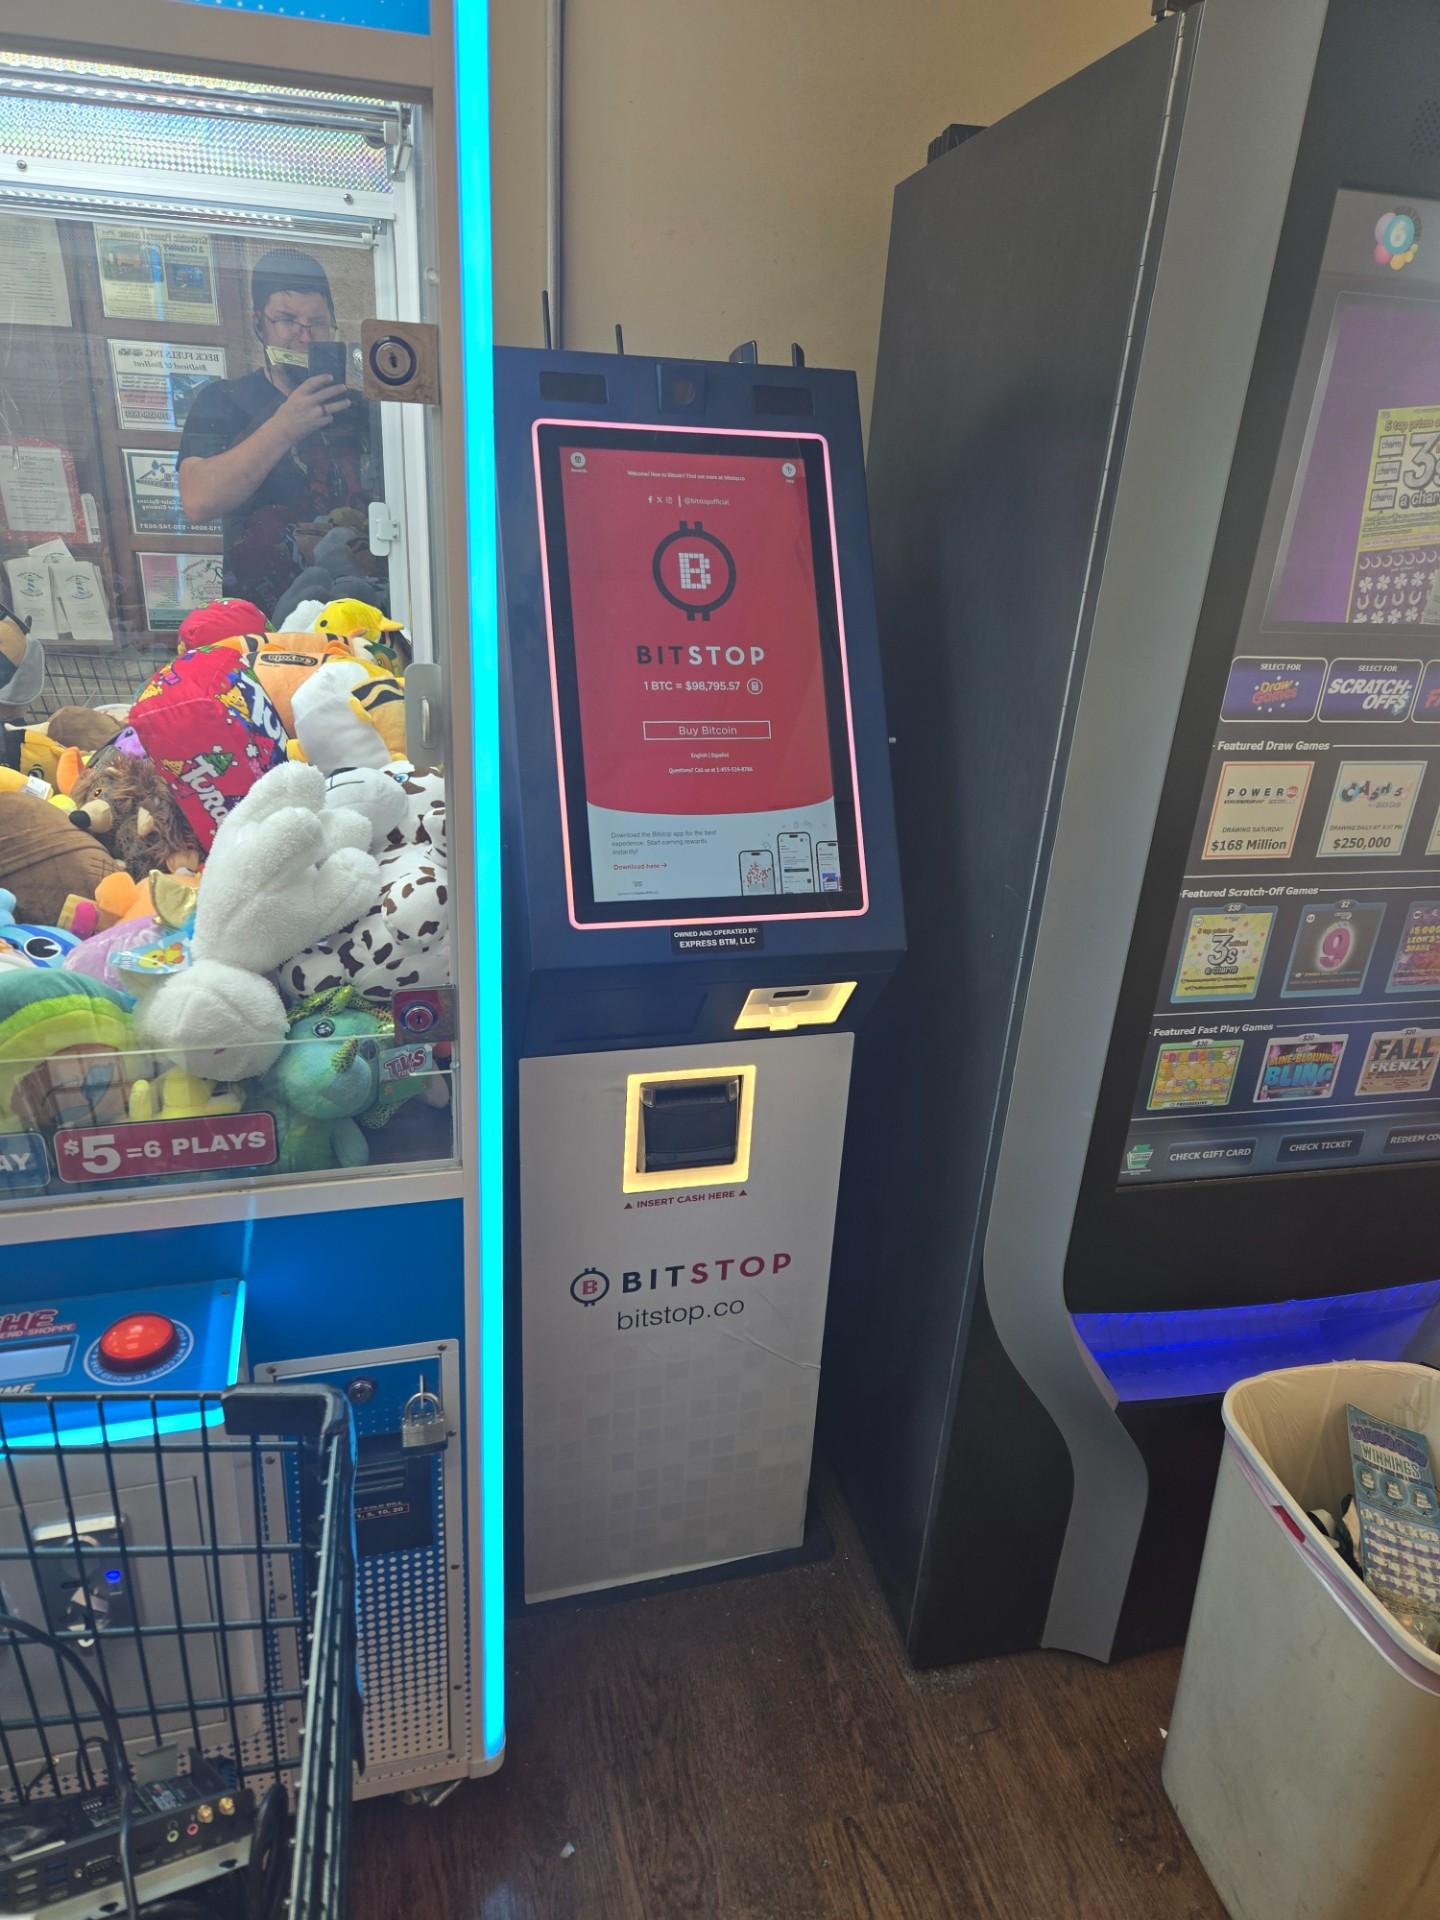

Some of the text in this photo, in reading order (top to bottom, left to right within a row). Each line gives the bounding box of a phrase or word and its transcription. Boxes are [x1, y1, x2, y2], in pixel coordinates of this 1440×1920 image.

[636, 645, 765, 666] BITSTOP
[1260, 663, 1285, 671] SELECT
[644, 681, 649, 691] 1
[651, 681, 673, 691] BTC
[1260, 680, 1294, 693] Draw
[678, 725, 737, 738] Buy Bitcoin
[1217, 741, 1330, 750] Featured Draw Games
[1227, 787, 1285, 797] POWER
[1252, 825, 1284, 833] SATURDAY
[1211, 839, 1287, 851] $168 Million
[1333, 836, 1391, 850] $250,000
[1182, 885, 1318, 899] Featured Scratch-Off Games
[674, 930, 698, 938] OWNED
[699, 929, 713, 937] AND
[713, 928, 748, 936] OPERATED
[680, 936, 756, 948] EXPRESS BTM, LLC
[1153, 1023, 1274, 1037] Featured Fast Play Games
[1372, 1038, 1435, 1060] FALL
[1370, 1059, 1431, 1073] FRENZY
[1264, 1063, 1335, 1087] BLING
[1390, 1133, 1425, 1144] REDEEM
[64, 1134, 121, 1174] $5
[171, 1131, 266, 1156] PLAYS
[1289, 1140, 1353, 1152] CHECK TICKET
[1169, 1147, 1251, 1162] CHECK GIFT CARD
[636, 1190, 735, 1209] INSERT CASH HERE
[622, 1252, 792, 1293] BITSTOP
[617, 1299, 745, 1331] bitstop.co
[1360, 1443, 1421, 1480] WINNINGS
